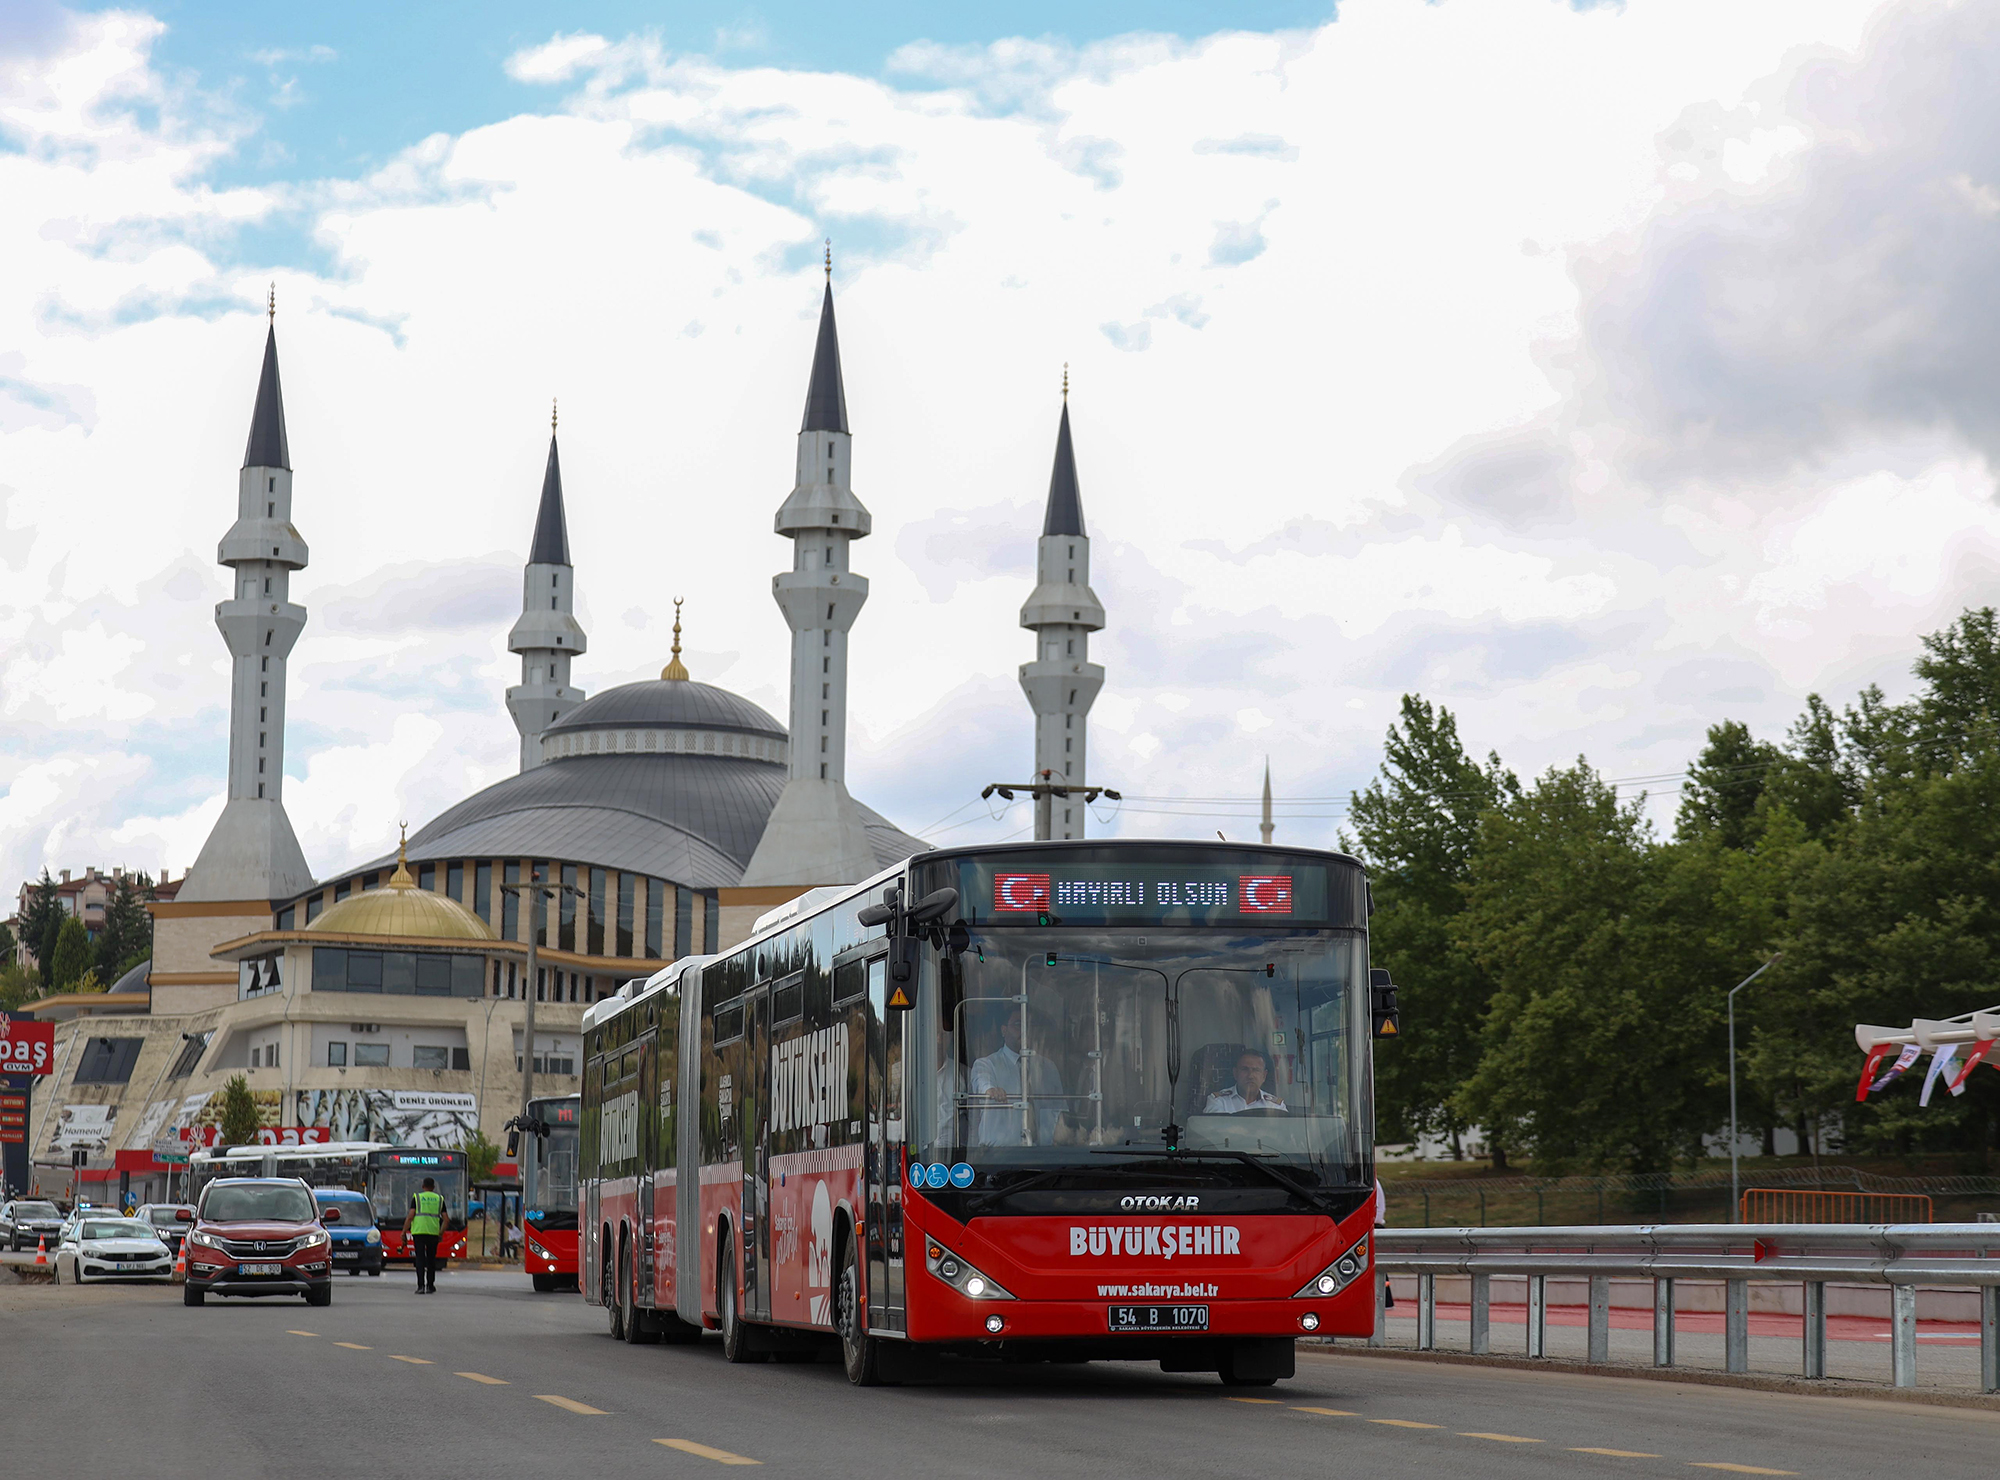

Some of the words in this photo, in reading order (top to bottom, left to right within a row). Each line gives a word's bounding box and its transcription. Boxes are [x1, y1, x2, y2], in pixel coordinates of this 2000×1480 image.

[1058, 881, 1144, 905] HAYIRLI
[1157, 882, 1228, 906] OLSUN
[771, 1022, 849, 1143] BÜYÜKŞEHİR
[399, 1095, 425, 1105] DENİZ
[428, 1096, 473, 1106] ÜRÜNLERİ
[558, 1109, 573, 1122] M1
[64, 1127, 102, 1136] Homend
[1121, 1196, 1199, 1210] OTOKAR
[1070, 1226, 1240, 1260] BÜYÜKŞEHİR
[1097, 1282, 1219, 1299] www.sakarya.bel.tr
[1119, 1308, 1136, 1325] 54
[1150, 1308, 1158, 1325] B
[1173, 1308, 1205, 1325] 1070
